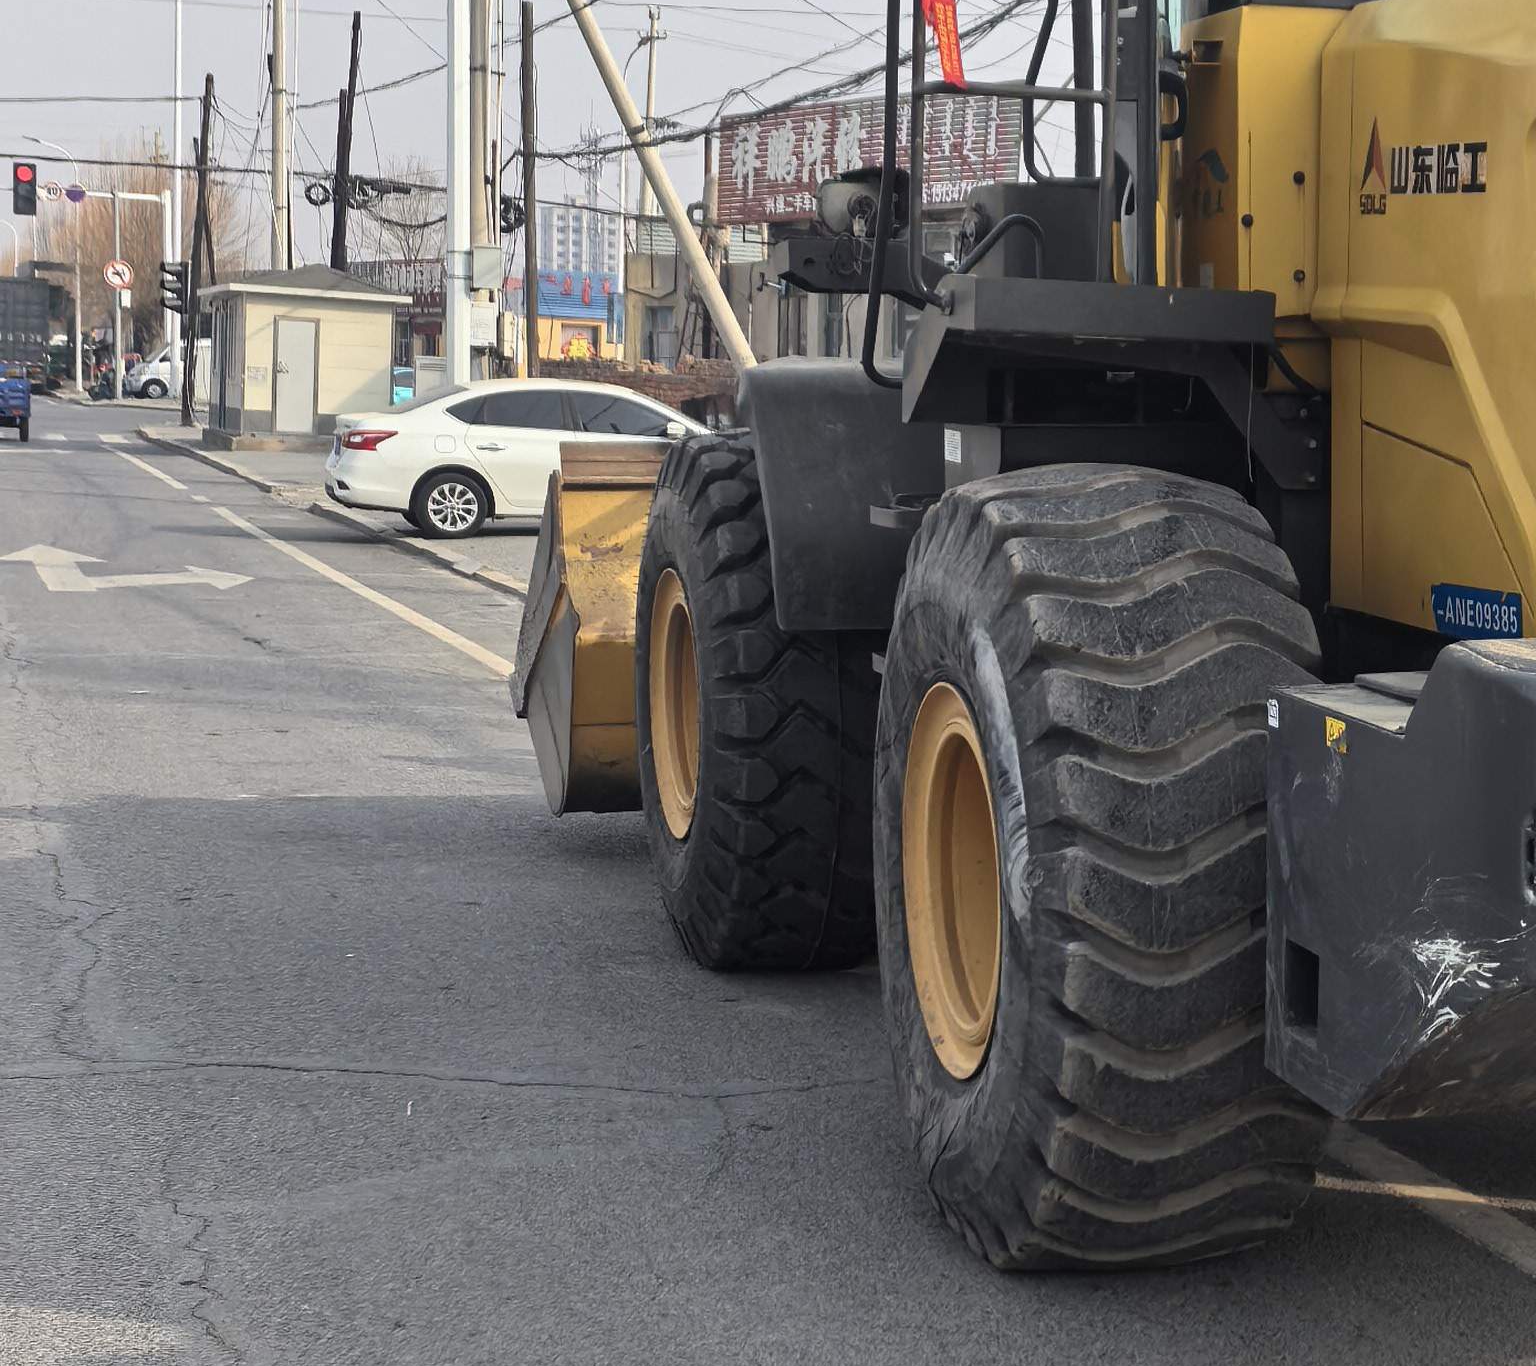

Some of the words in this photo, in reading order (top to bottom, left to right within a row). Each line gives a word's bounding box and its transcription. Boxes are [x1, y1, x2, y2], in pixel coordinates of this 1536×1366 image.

[1390, 141, 1487, 195] 山东临工
[1359, 193, 1387, 215] SDLG
